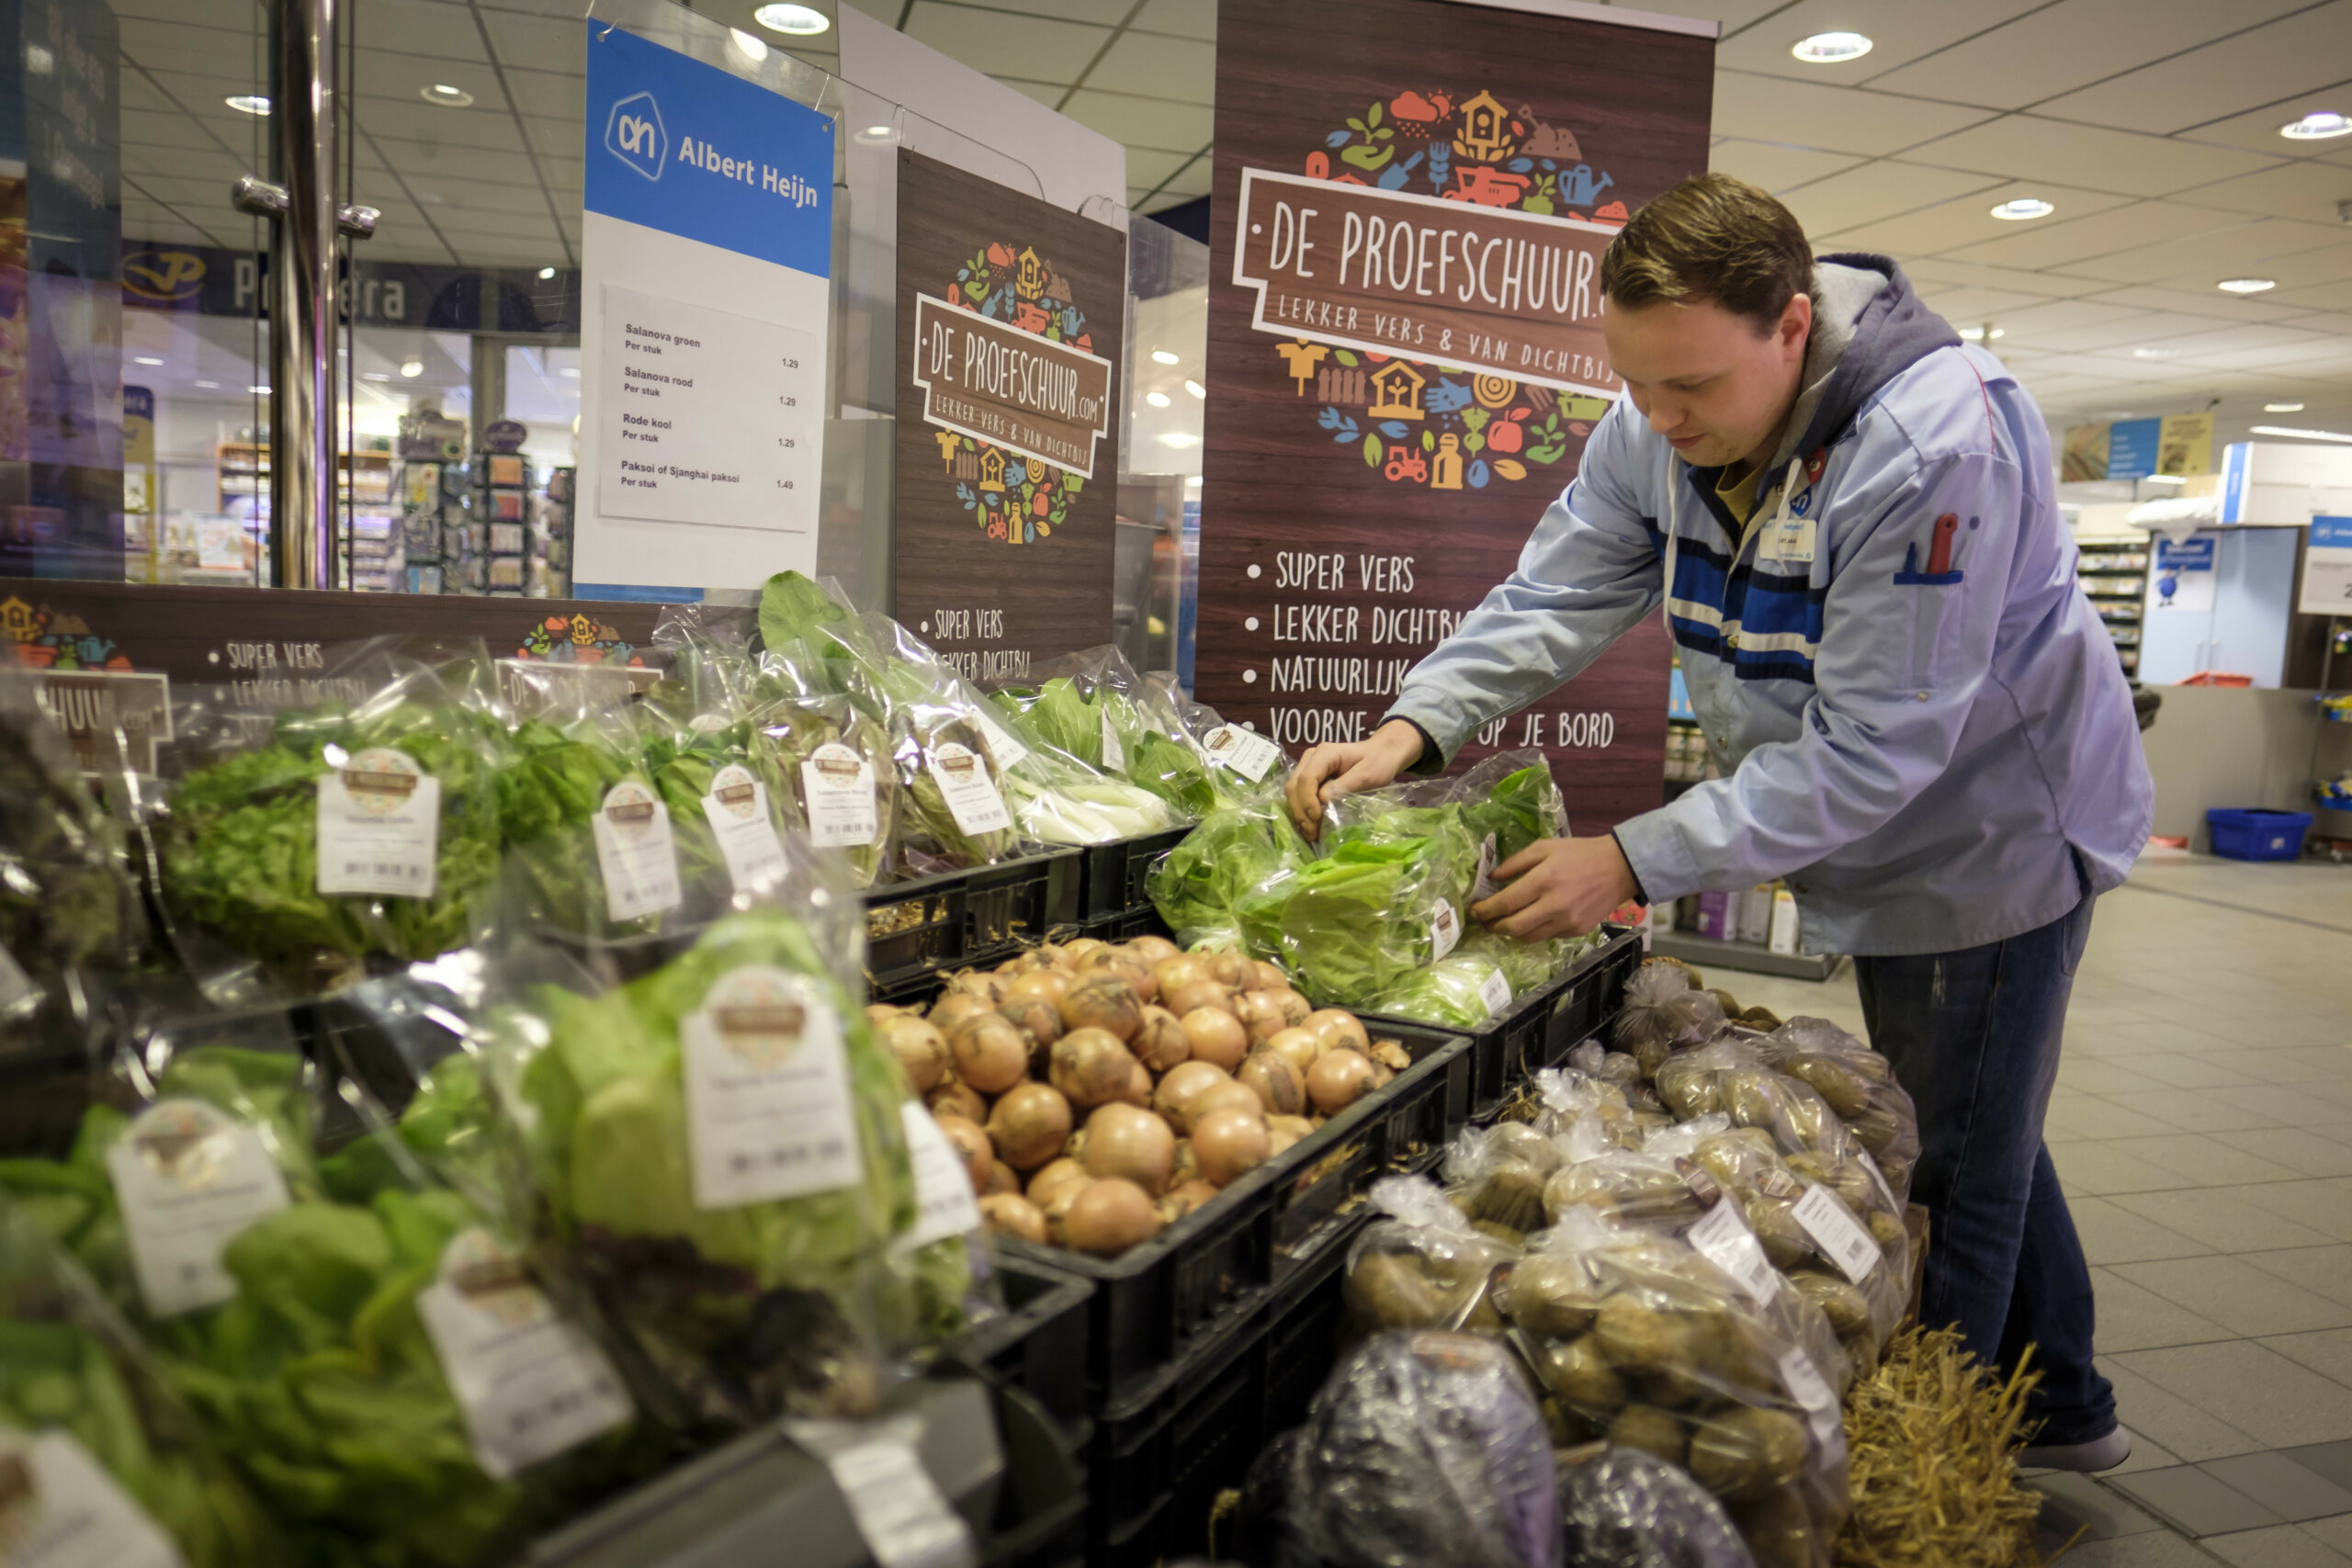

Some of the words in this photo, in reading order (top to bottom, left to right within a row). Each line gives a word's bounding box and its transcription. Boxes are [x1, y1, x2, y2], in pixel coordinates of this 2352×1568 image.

[678, 136, 754, 186] Albert
[763, 164, 818, 209] Heijn
[1270, 201, 1318, 277] DE
[626, 323, 672, 342] Salanova
[674, 335, 701, 348] groen
[1278, 294, 1358, 331] LEKKER
[1374, 313, 1426, 344] VERS
[1439, 329, 1453, 352] &
[1469, 333, 1509, 363] VAN
[625, 340, 640, 350] Per
[642, 344, 662, 355] stuk
[932, 321, 955, 381] DE
[782, 357, 798, 368] 1.29
[624, 383, 639, 393] Per
[641, 386, 661, 397] stuk
[625, 367, 670, 383] Salanova
[673, 377, 693, 388] rood
[779, 396, 796, 407] 1.29
[623, 413, 649, 426] Rode
[651, 418, 672, 430] kool
[936, 393, 974, 423] LEKKER
[981, 411, 1005, 435] VERS
[1010, 423, 1018, 441] &
[1023, 427, 1042, 450] VAN
[1046, 435, 1088, 466] DICHTBIJ
[622, 430, 638, 440] Per
[639, 433, 659, 443] stuk
[778, 438, 795, 448] 1.29
[621, 460, 655, 473] Paksoi
[658, 465, 667, 475] of
[670, 467, 709, 480] Sjanghai
[711, 472, 740, 484] paksoi
[621, 477, 636, 487] Per
[639, 479, 658, 489] stuk
[776, 479, 794, 490] 1.49
[1276, 551, 1345, 592] SUPER
[1361, 554, 1415, 593] VERS
[935, 609, 969, 640] SUPER
[976, 609, 1003, 638] VERS
[1274, 604, 1359, 644] LEKKER
[227, 643, 277, 670] SUPER
[283, 642, 323, 669] VERS
[983, 649, 1030, 681] DICHTBIJ
[1520, 714, 1545, 748] JE
[1559, 712, 1614, 748] BORD
